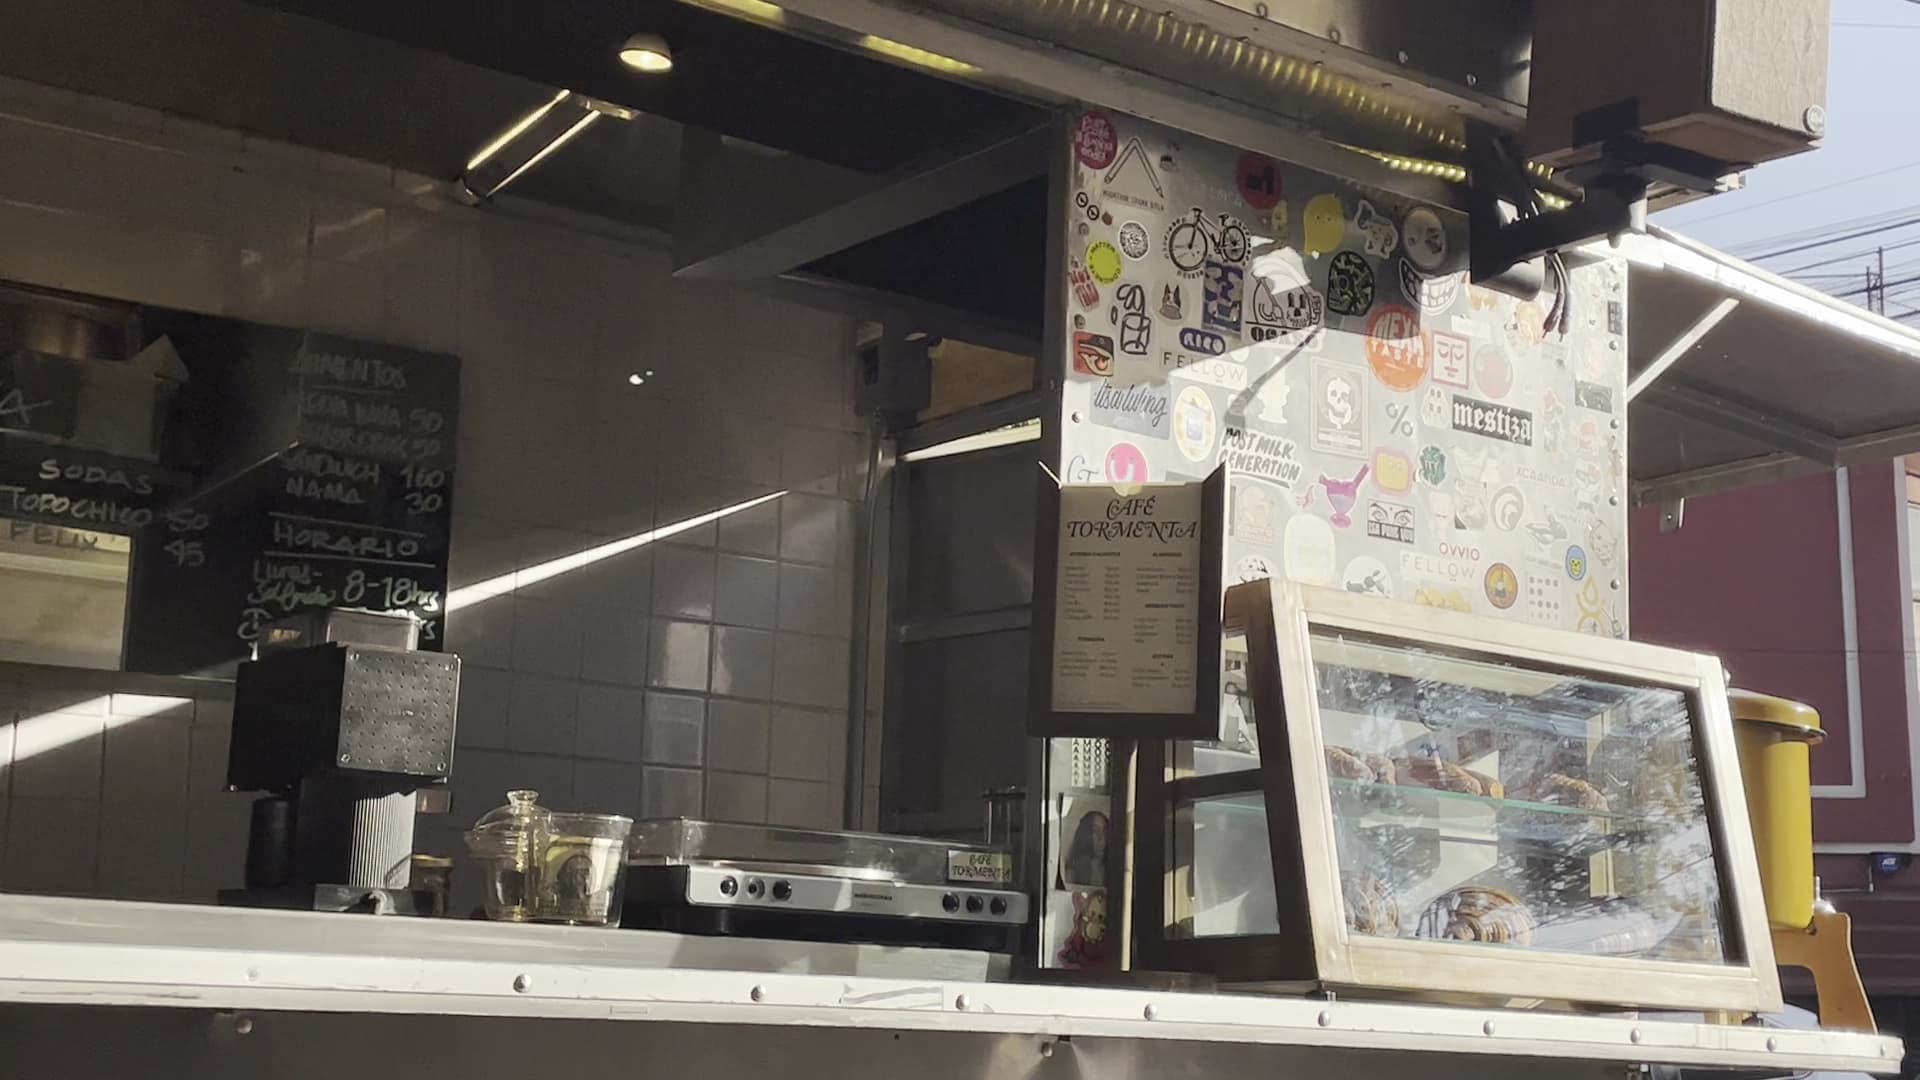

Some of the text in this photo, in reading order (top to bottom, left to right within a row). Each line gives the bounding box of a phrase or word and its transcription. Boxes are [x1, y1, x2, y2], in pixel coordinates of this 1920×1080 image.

[1163, 352, 1245, 381] FELLOW
[1453, 401, 1532, 441] mestiza
[1254, 435, 1295, 460] MILK
[39, 459, 153, 494] SODAS
[1106, 496, 1156, 520] CAFÉ
[273, 520, 419, 557] HORARIO
[1066, 520, 1198, 544] TORMENTA
[1439, 542, 1480, 561] OVVIO
[1402, 553, 1476, 578] FELLOW
